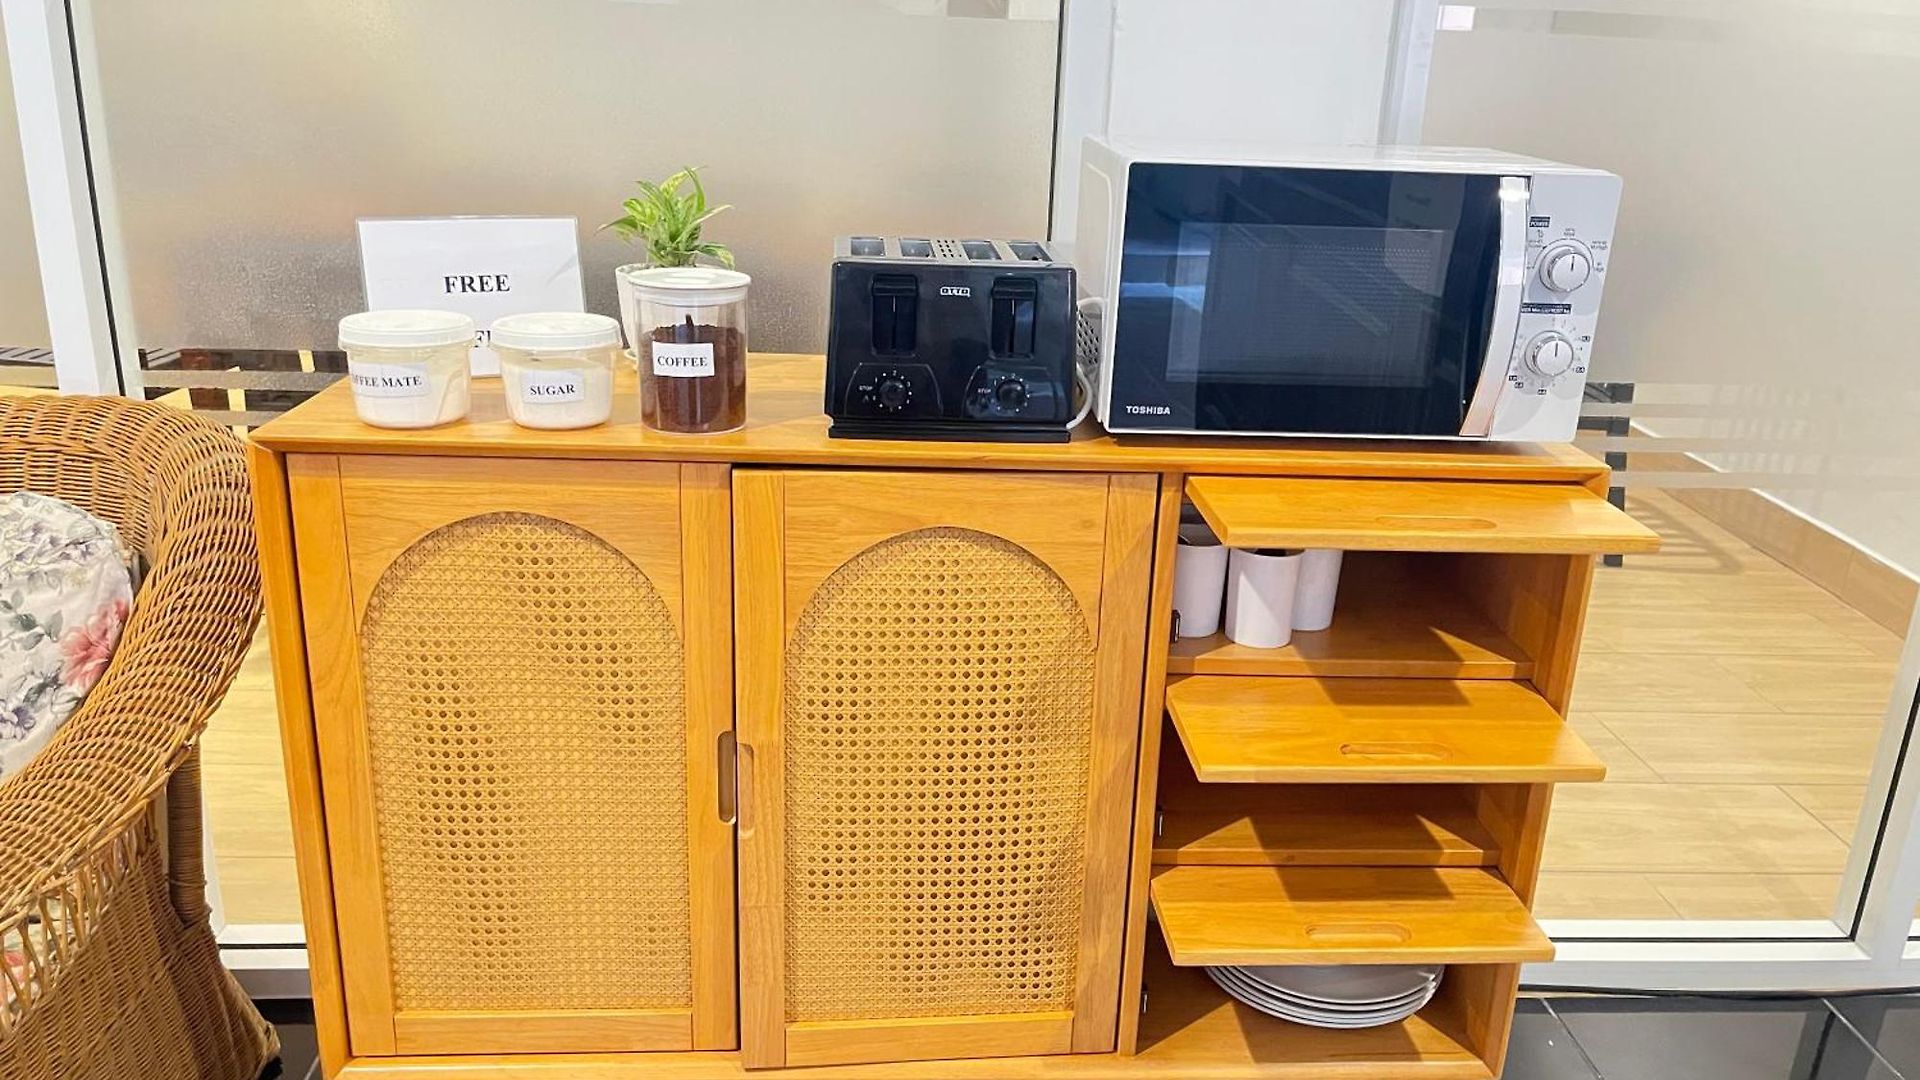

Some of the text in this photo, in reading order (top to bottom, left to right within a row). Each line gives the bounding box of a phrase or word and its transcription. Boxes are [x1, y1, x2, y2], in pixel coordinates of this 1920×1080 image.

[444, 274, 510, 293] FREE
[657, 356, 707, 367] COFFEE
[382, 376, 422, 388] MATE
[530, 384, 575, 395] SUGAR
[1125, 405, 1170, 415] TOSHIBA
